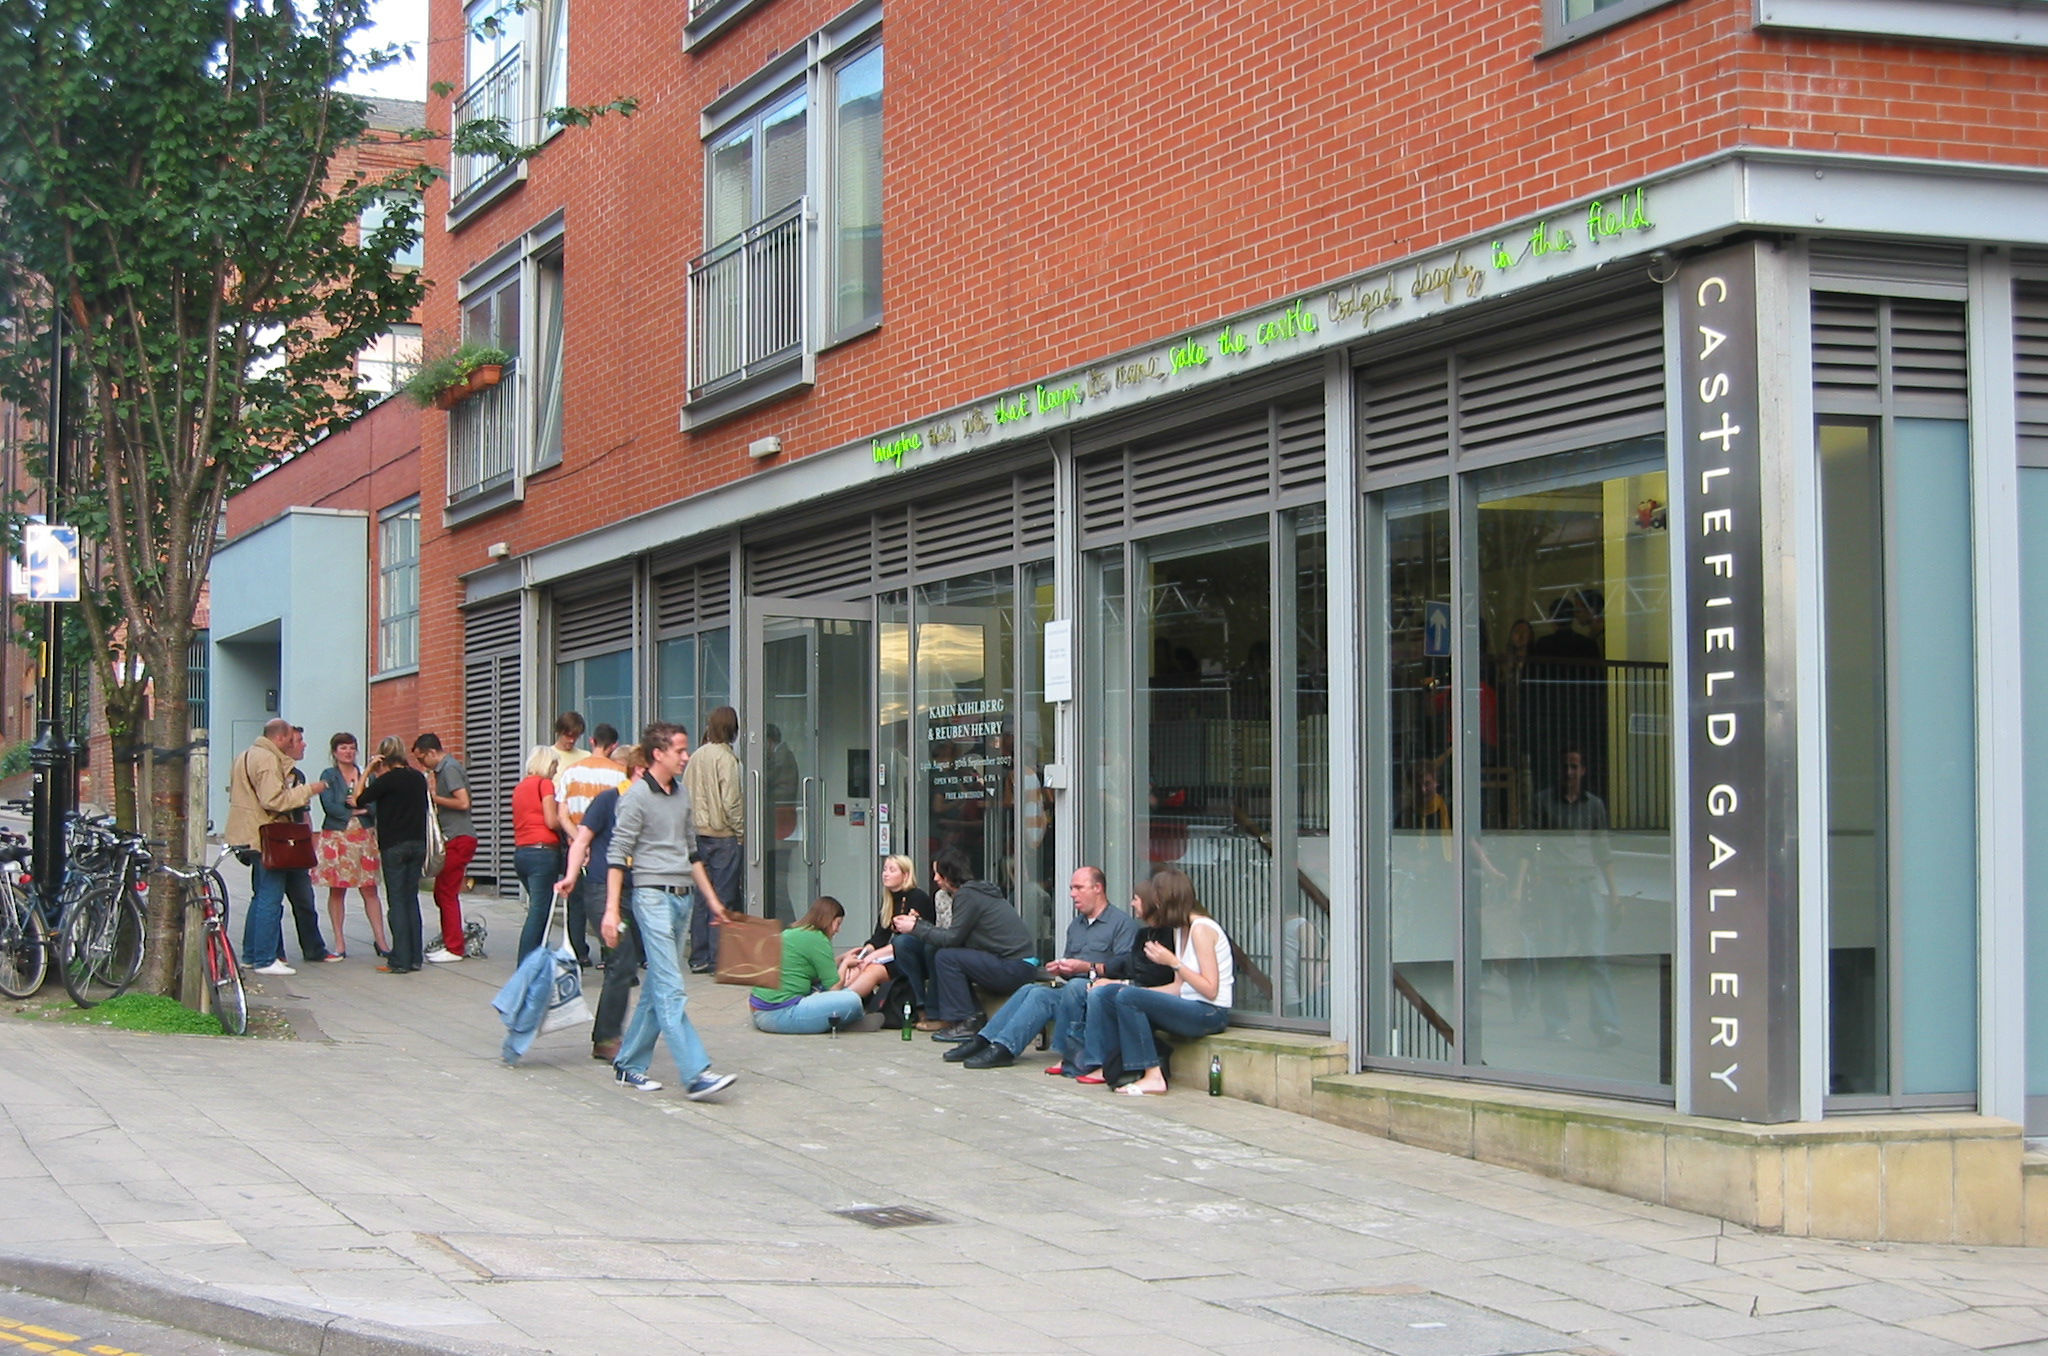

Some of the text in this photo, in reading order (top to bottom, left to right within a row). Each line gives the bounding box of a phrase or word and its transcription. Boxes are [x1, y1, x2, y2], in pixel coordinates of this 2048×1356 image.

[994, 393, 1030, 425] that
[1217, 325, 1247, 356] the
[1256, 299, 1317, 345] castle
[1491, 241, 1514, 269] in
[1528, 221, 1573, 257] the
[1586, 187, 1651, 242] field
[928, 721, 1004, 741] & REUBEN HENRY
[929, 699, 1004, 719] KARIN KIHLBERG
[1698, 276, 1741, 1093] CASTLEFIELD GALLERY
